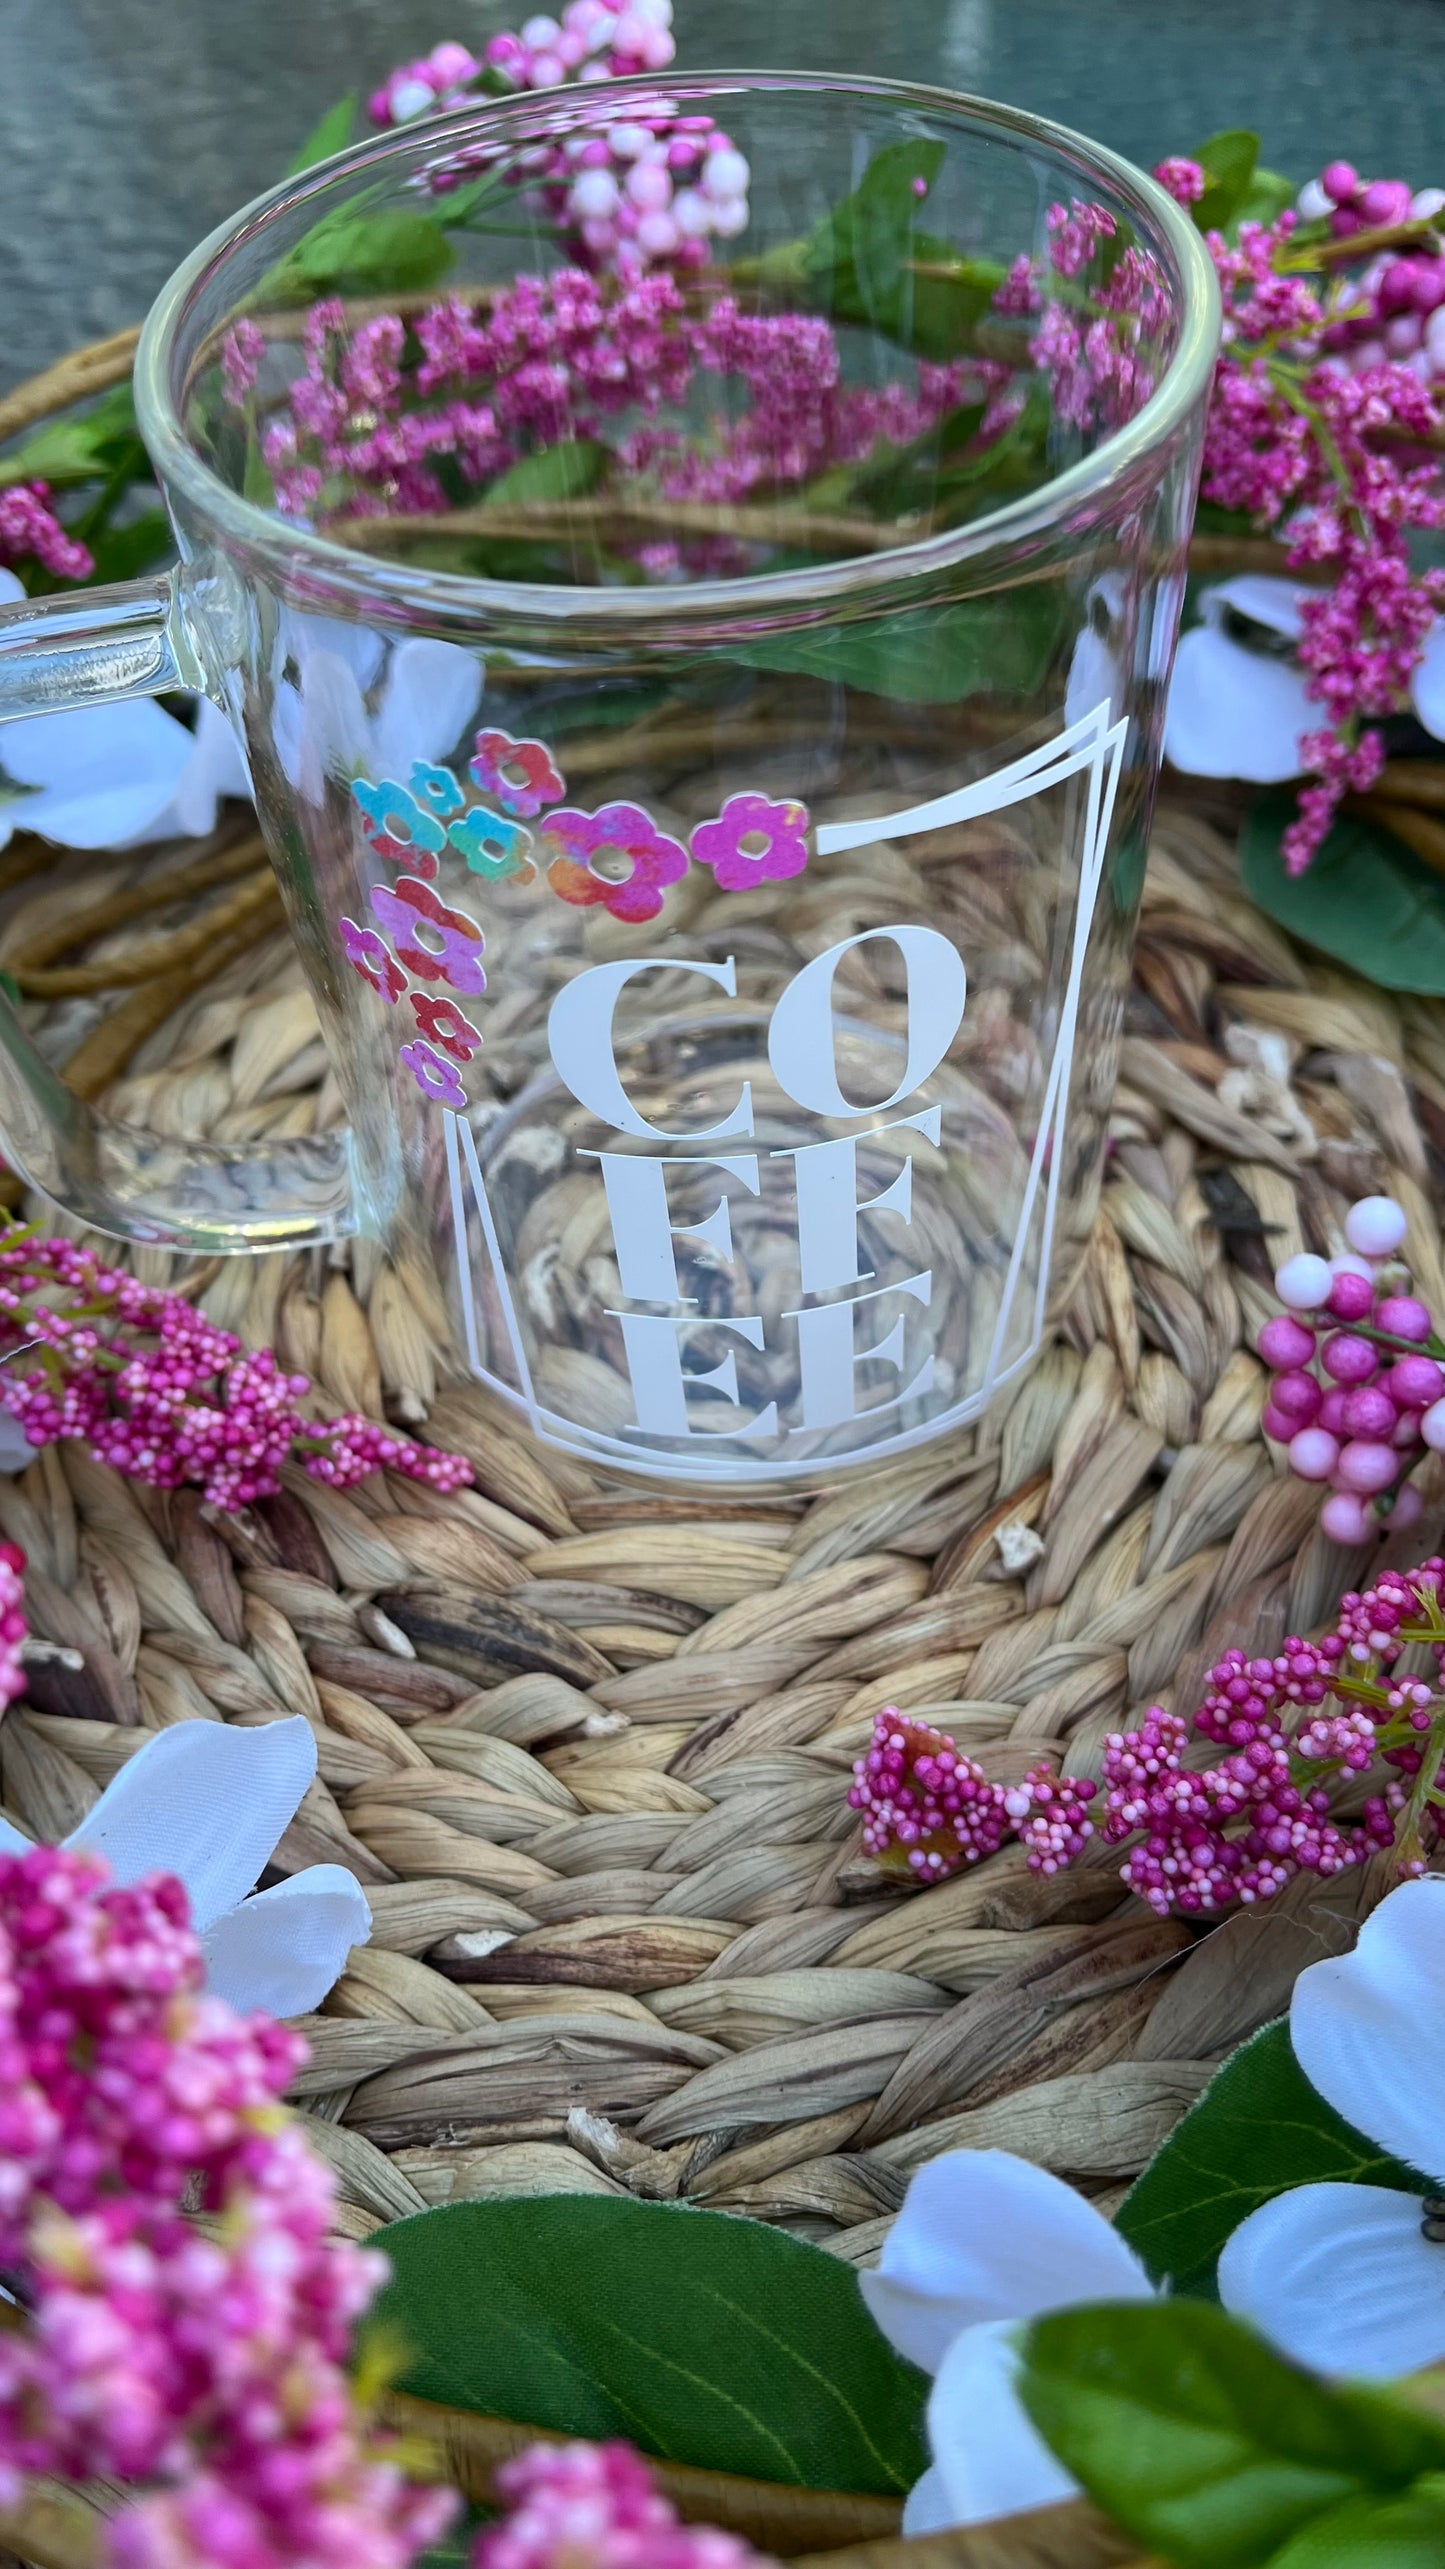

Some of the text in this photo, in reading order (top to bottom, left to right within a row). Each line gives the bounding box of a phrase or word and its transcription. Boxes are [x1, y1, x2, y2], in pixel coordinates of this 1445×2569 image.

[547, 924, 967, 1141] CO
[575, 1104, 942, 1304] FF
[603, 1269, 935, 1439] EE
